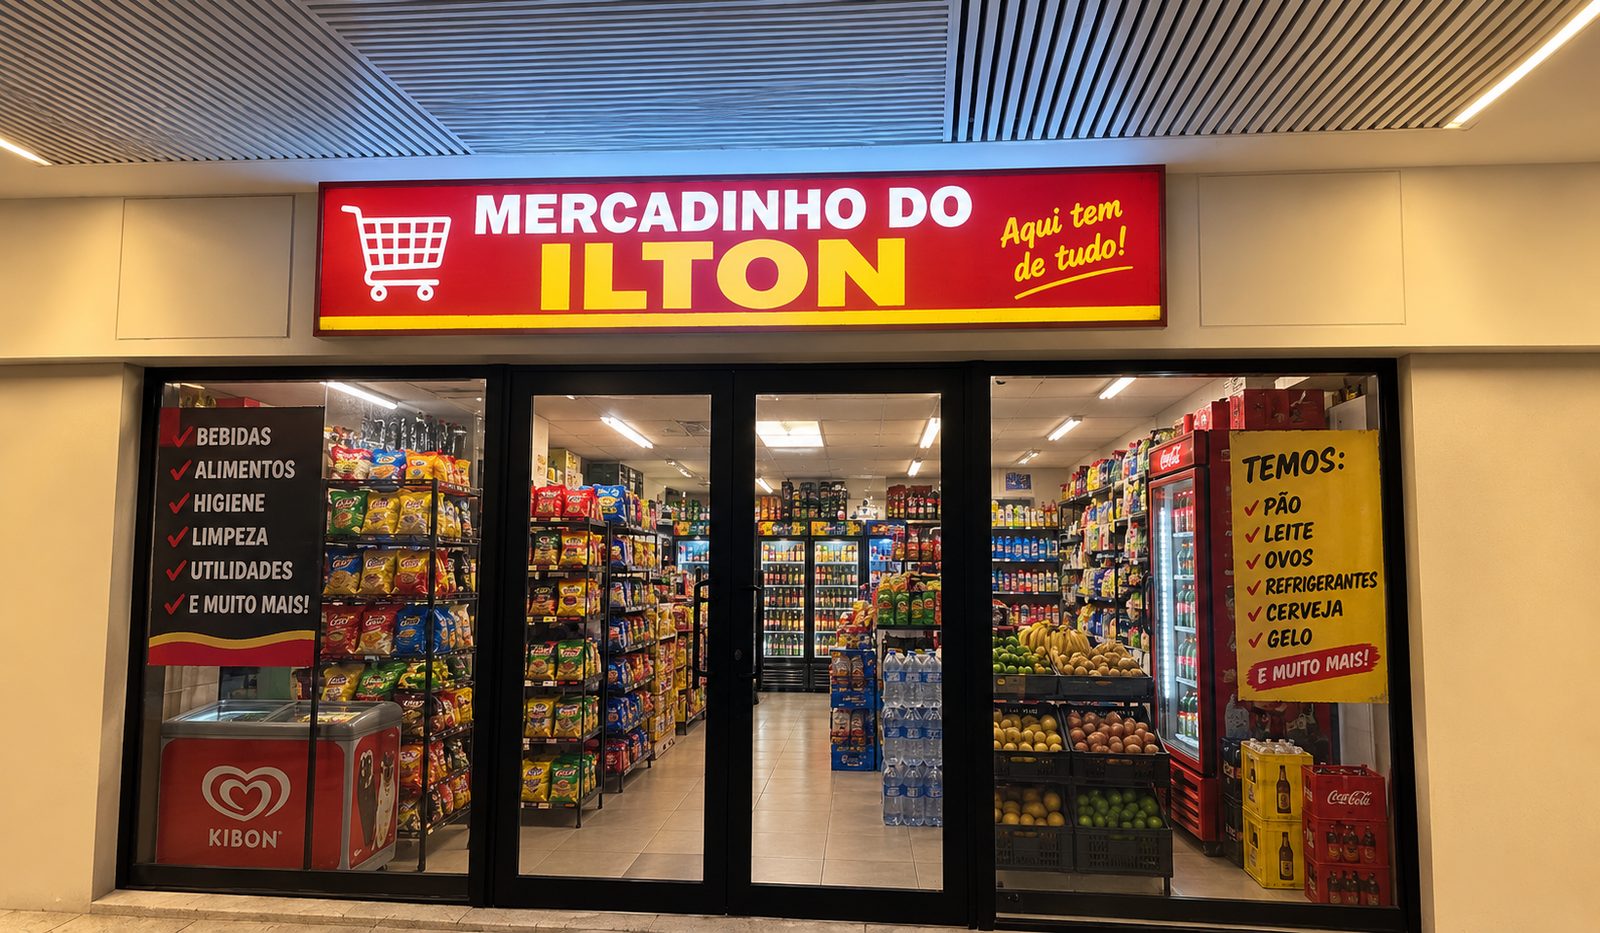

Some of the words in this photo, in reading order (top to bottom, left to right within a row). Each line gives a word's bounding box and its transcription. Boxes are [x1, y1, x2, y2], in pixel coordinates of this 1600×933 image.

[474, 187, 867, 236] MERCADINHO
[888, 185, 973, 229] DO
[1000, 208, 1063, 250] Aqui
[1070, 199, 1123, 230] tem
[1013, 251, 1046, 283] de
[1054, 225, 1128, 271] tudo!
[540, 237, 906, 311] ILTON
[196, 426, 272, 447] BEBIDAS
[194, 459, 296, 479] ALIMENTOS
[1241, 446, 1346, 484] TEMOS:
[193, 493, 266, 513] HIGIENE
[1263, 491, 1302, 516] PÃO
[192, 527, 269, 546] LIMPEZA
[1264, 521, 1315, 544] LEITE
[190, 560, 294, 581] UTILIDADES
[1264, 548, 1314, 570] OVOS
[1265, 571, 1378, 596] REFRIGERANTES
[188, 594, 200, 614] E
[203, 594, 257, 614] MUITO
[261, 594, 310, 614] MAIS!
[1266, 599, 1343, 622] CERVEJA
[1267, 627, 1313, 649] GELO
[1257, 667, 1267, 685] E
[1272, 658, 1321, 682] MUITO
[1325, 649, 1370, 673] MAIS!
[208, 827, 278, 849] KIBON
